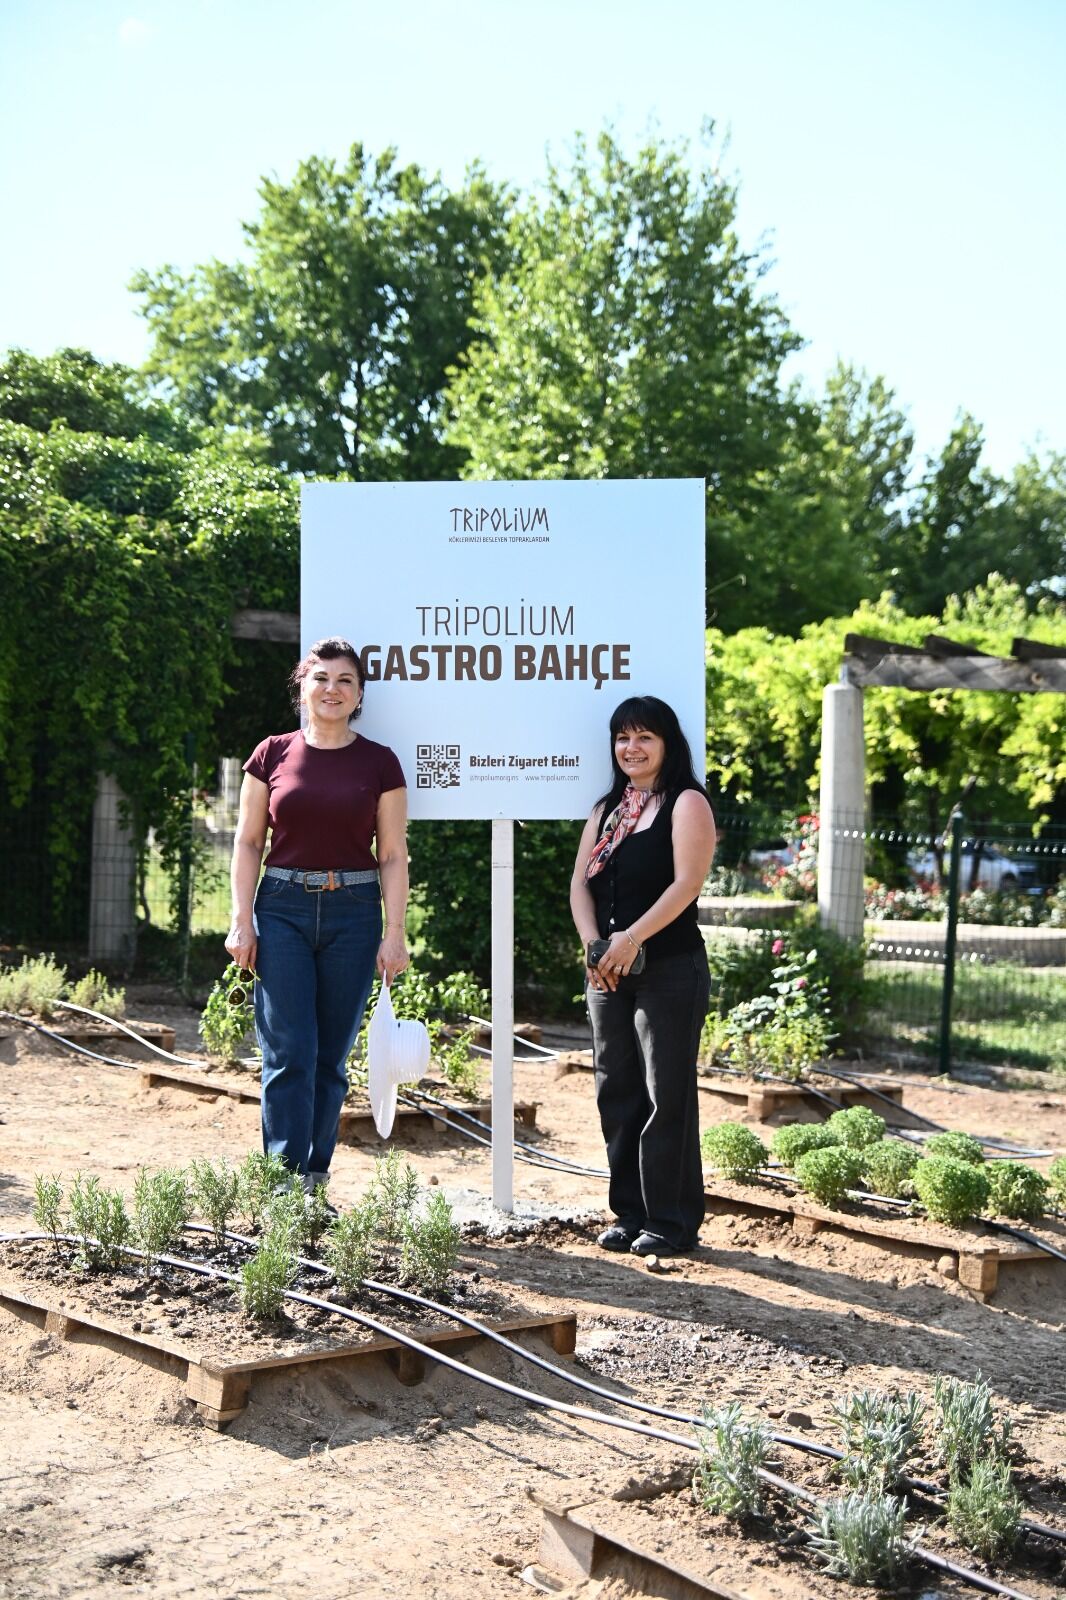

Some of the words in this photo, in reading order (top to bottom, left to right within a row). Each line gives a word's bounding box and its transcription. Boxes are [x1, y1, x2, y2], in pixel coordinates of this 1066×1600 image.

[415, 598, 575, 637] TRİPOLİUM
[360, 644, 503, 681] GASTRO
[514, 644, 631, 690] BAHÇE
[469, 755, 506, 767] Bizleri
[508, 755, 549, 770] Ziyaret
[551, 755, 580, 767] Edin!
